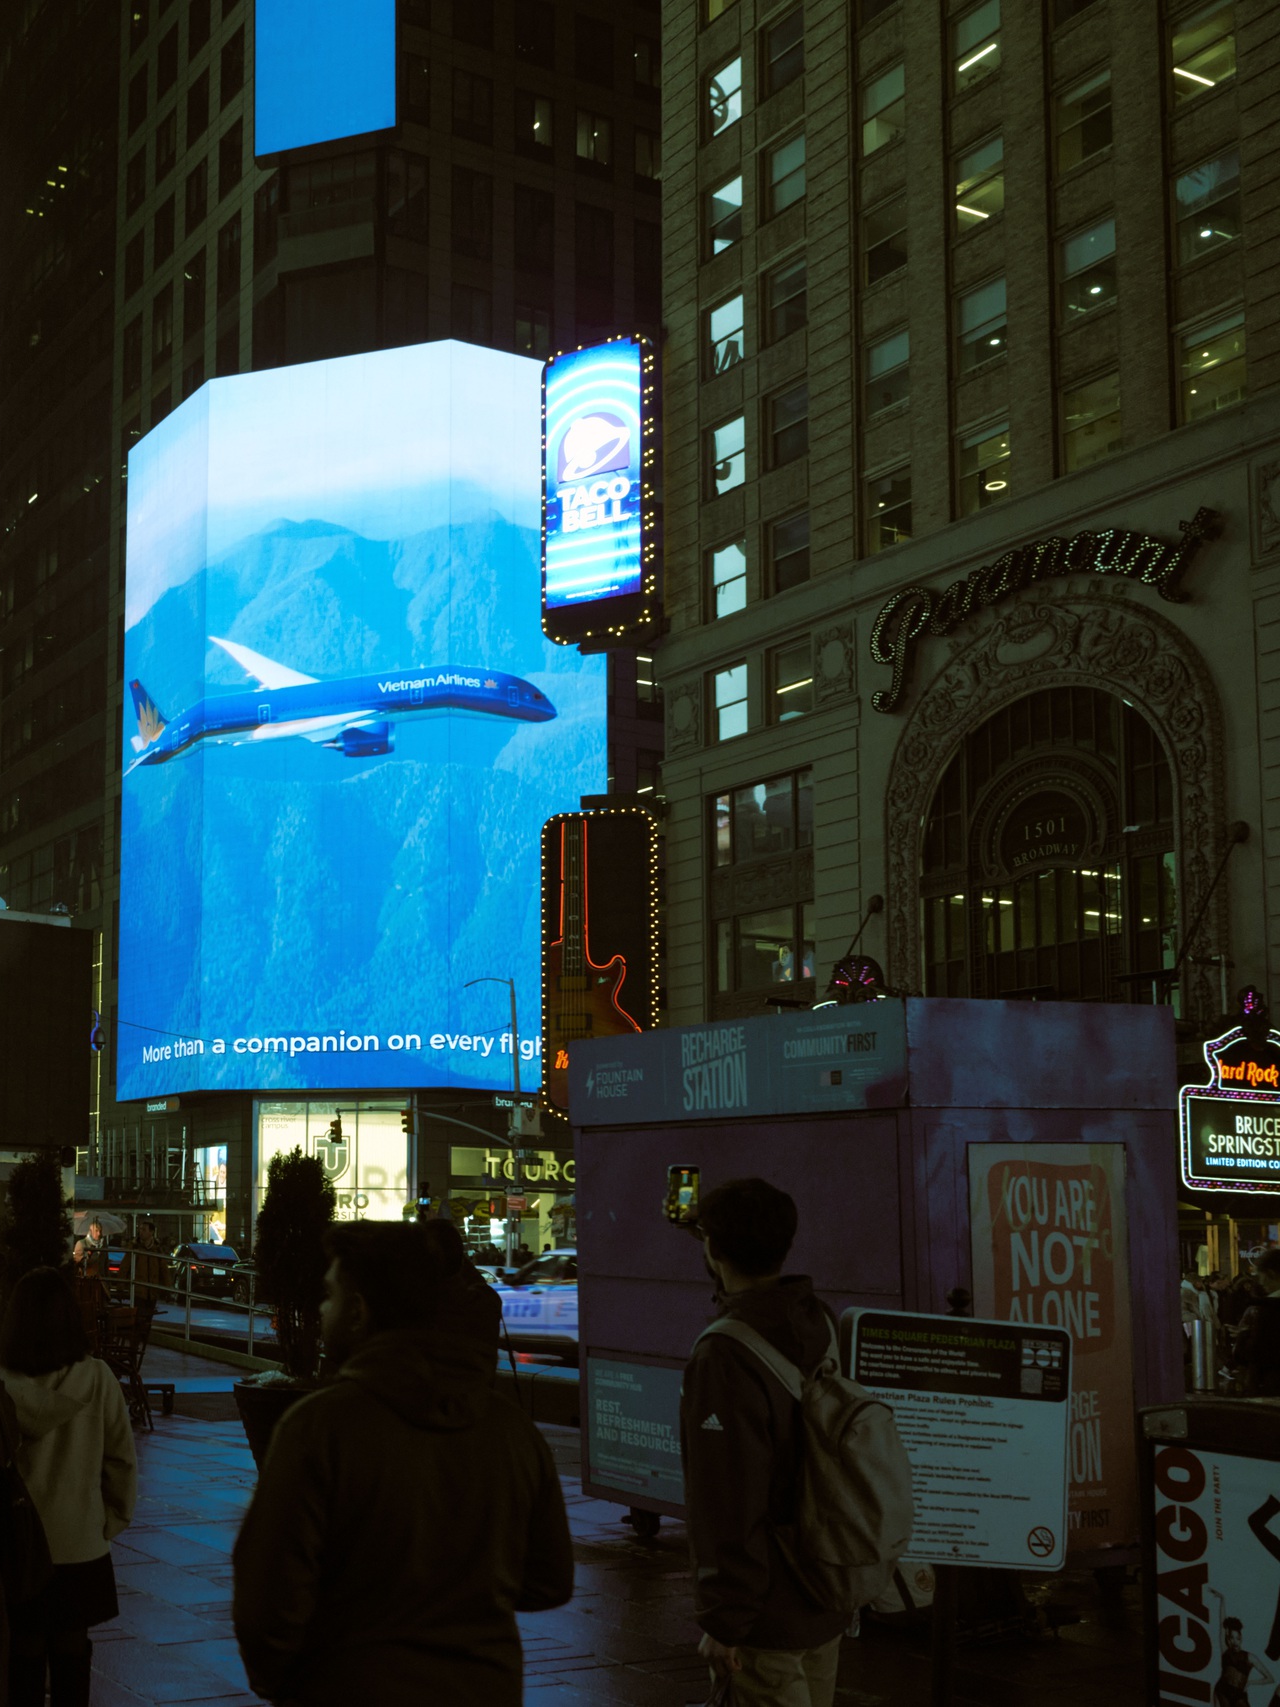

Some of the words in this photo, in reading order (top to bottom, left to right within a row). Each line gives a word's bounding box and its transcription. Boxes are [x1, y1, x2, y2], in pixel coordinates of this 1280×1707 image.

[556, 476, 631, 511] TACO
[562, 500, 632, 533] BELL
[871, 507, 1220, 713] Paramount
[378, 678, 435, 693] Vietnam
[436, 674, 481, 688] Airlines
[1024, 816, 1065, 840] 1501
[1013, 843, 1079, 867] BROADWAY
[143, 1045, 172, 1064] More
[173, 1037, 204, 1058] than
[211, 1038, 226, 1054] a
[233, 1030, 379, 1057] companion
[387, 1033, 422, 1050] on
[429, 1033, 495, 1057] every
[499, 1032, 542, 1061] flgh
[681, 1026, 747, 1068] RECHARGE
[595, 1068, 644, 1085] FOUNTAIN
[682, 1050, 748, 1112] STATION
[1247, 1061, 1280, 1087] Rock
[596, 1083, 629, 1099] HOUSE
[146, 1101, 167, 1112] branded
[1235, 1115, 1280, 1136] BRUCE
[1205, 1156, 1235, 1167] LIMITED
[1236, 1157, 1267, 1168] EDITION
[1006, 1175, 1049, 1226] YOU
[1055, 1179, 1098, 1232] ARE
[1010, 1230, 1100, 1292] NOT
[862, 1327, 890, 1340] TIMES
[891, 1329, 929, 1342] SQUARE
[930, 1334, 986, 1348] PEDESTRIAN
[987, 1338, 1016, 1350] PLAZA
[908, 1393, 931, 1403] Plaza
[933, 1395, 956, 1405] Rules
[596, 1412, 675, 1441] REFRESHMENT,
[596, 1426, 619, 1441] AND
[621, 1431, 682, 1455] RESOURCES
[1212, 1464, 1221, 1495] PARTY
[1155, 1446, 1213, 1707] ICAGO
